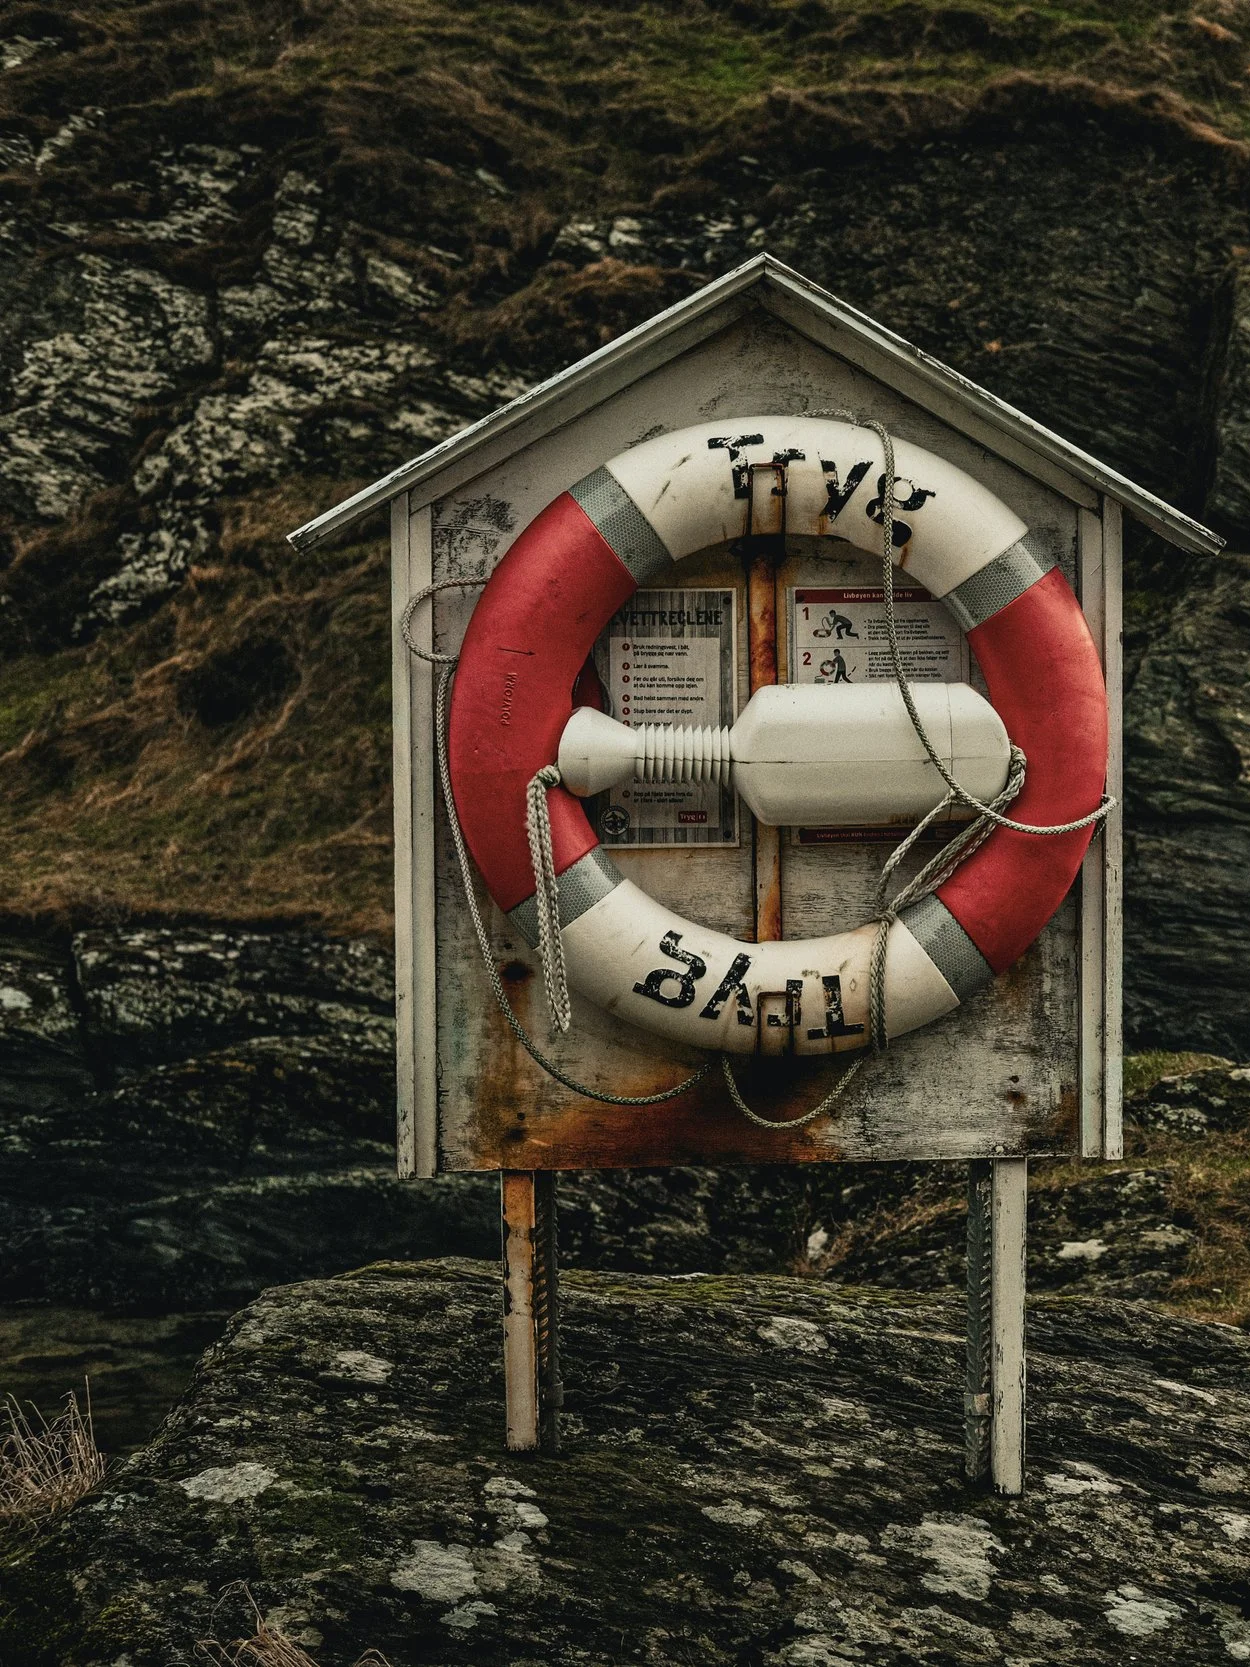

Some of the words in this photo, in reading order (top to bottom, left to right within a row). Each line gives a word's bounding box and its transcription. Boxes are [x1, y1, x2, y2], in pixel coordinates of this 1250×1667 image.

[708, 433, 936, 547] Tryg
[802, 607, 810, 620] 1
[802, 652, 812, 665] 2
[632, 930, 864, 1040] Tryg
